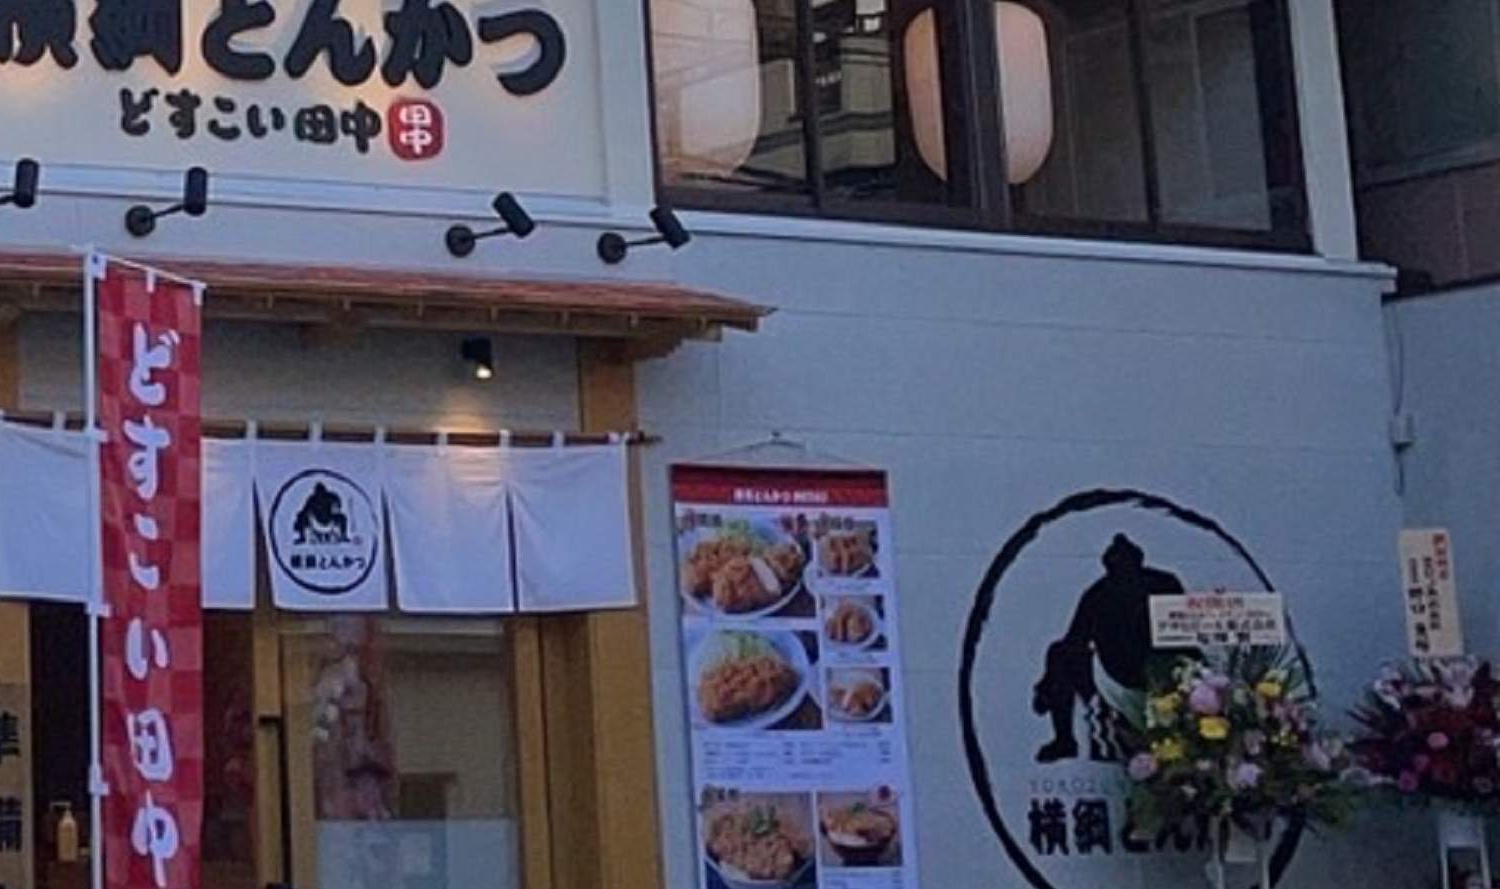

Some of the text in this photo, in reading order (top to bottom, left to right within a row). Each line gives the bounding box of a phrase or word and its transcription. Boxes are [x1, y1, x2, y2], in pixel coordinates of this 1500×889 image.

[120, 88, 380, 154] どすこい田中
[400, 105, 433, 154] 田中
[124, 322, 180, 886] どすこい田中
